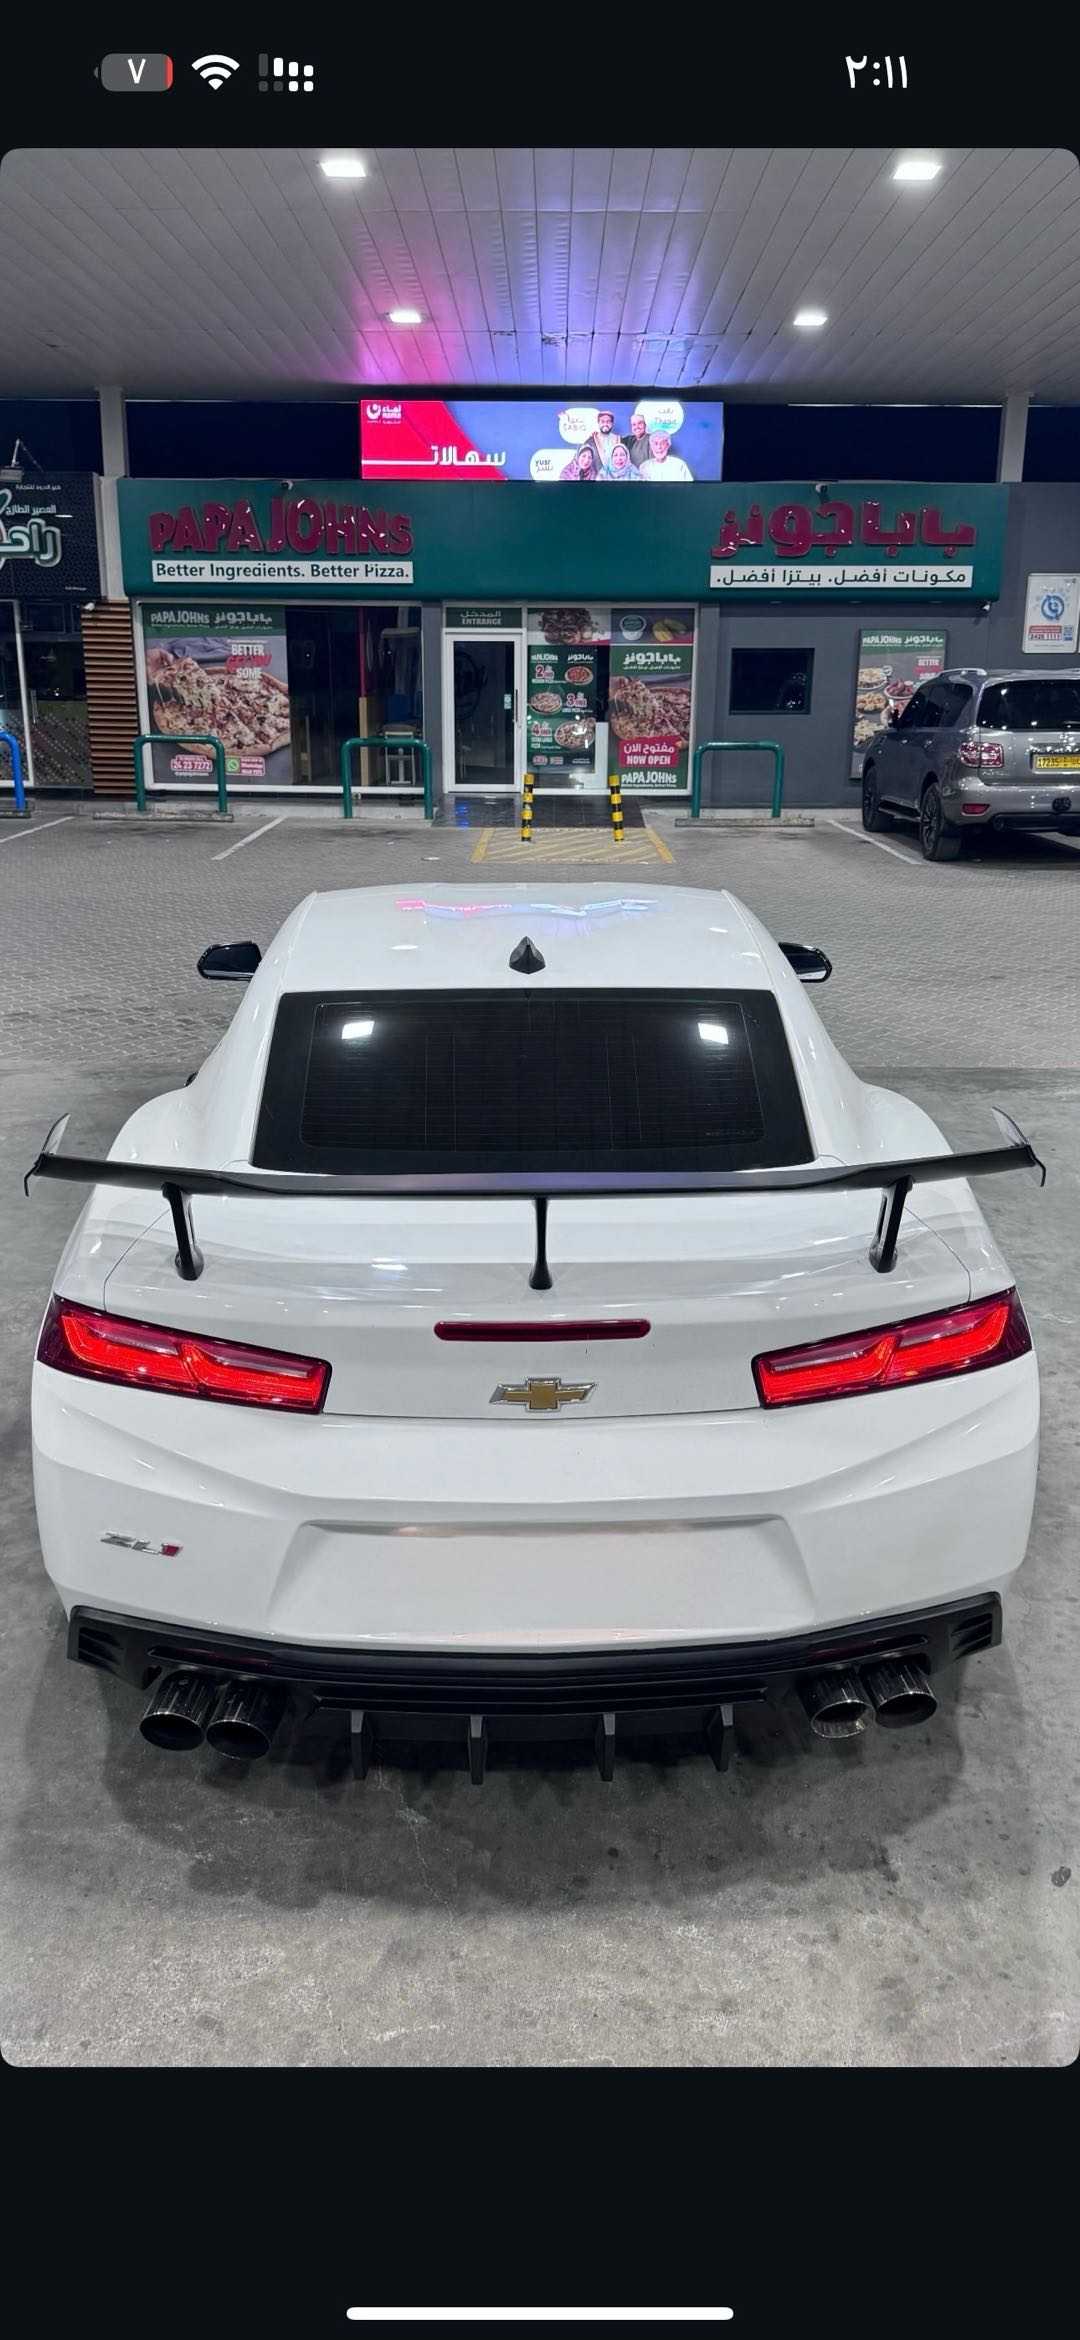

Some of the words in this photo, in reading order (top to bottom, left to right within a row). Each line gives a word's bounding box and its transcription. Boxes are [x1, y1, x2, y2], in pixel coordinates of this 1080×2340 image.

[32, 505, 57, 516] العصير
[156, 563, 205, 577] Better
[210, 563, 305, 580] Ingredients.
[311, 563, 359, 578] Better
[365, 563, 409, 578] Pizza.
[717, 568, 776, 586] أفضل.
[782, 569, 821, 586] بيتزا
[828, 568, 888, 584] أفضل.
[893, 570, 966, 585] مكونات
[460, 610, 501, 618] المدخل
[462, 618, 502, 626] ENTRANCE
[231, 644, 265, 657] BETTER
[643, 743, 675, 754] مفتوح
[627, 756, 646, 765] NOW
[648, 756, 671, 765] OPEN
